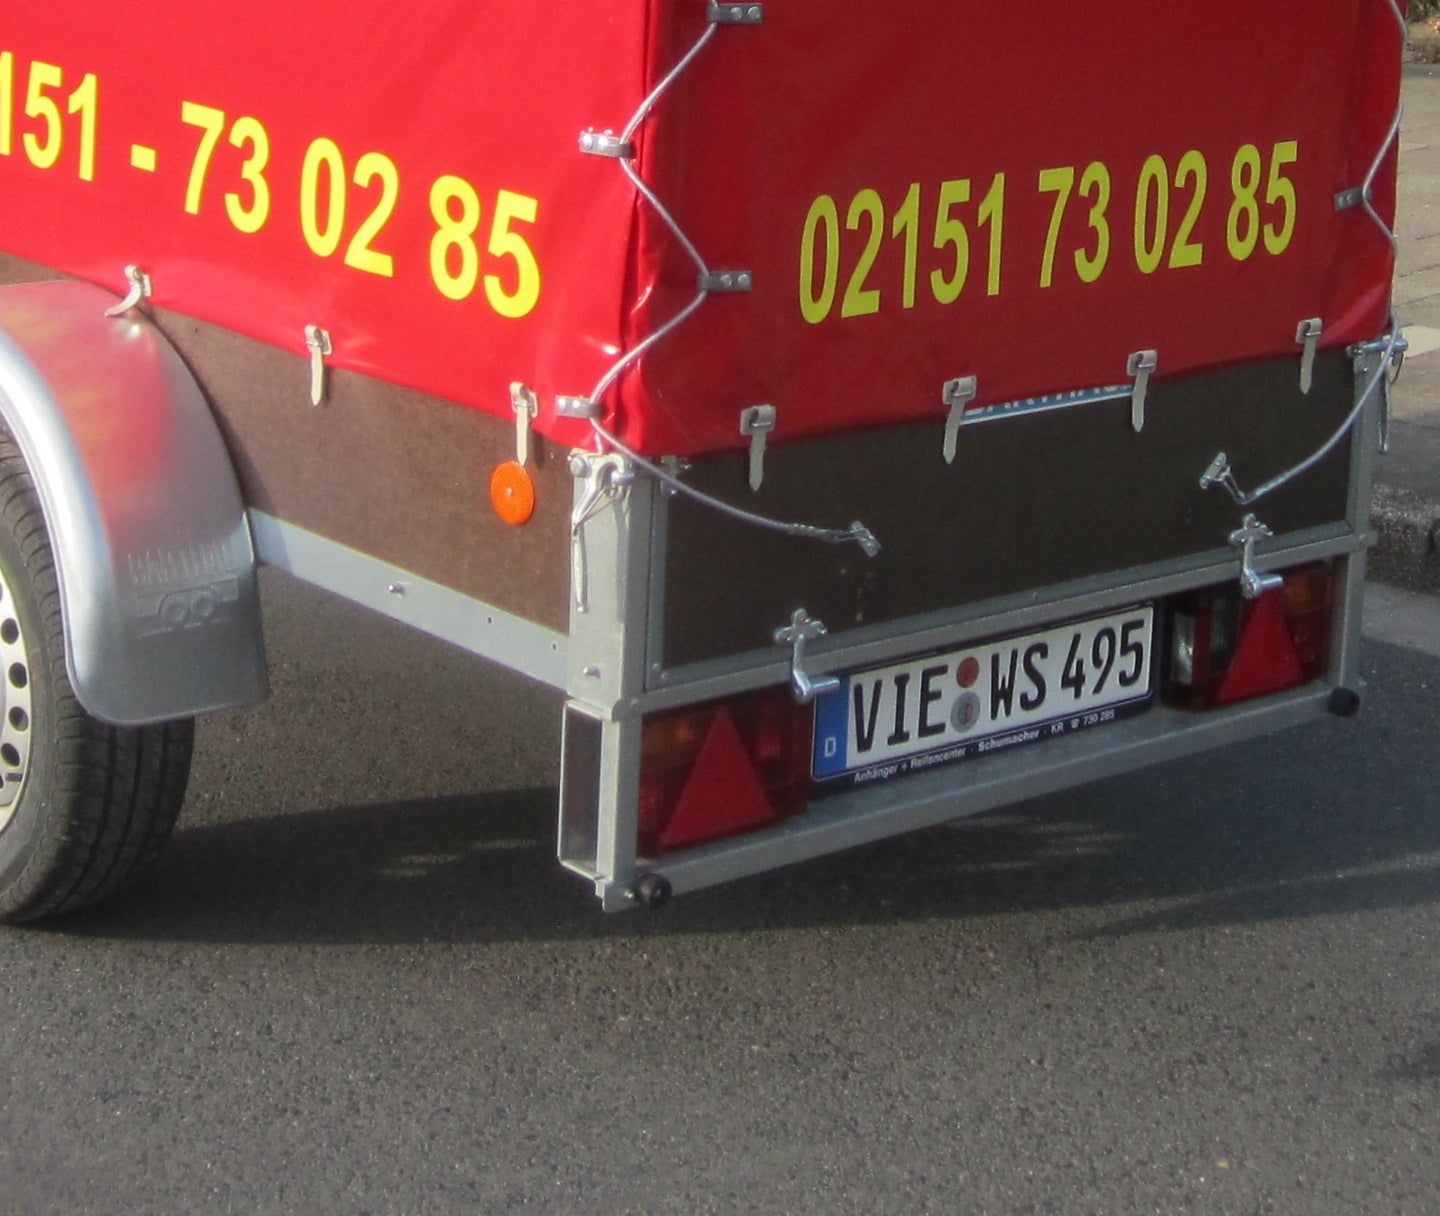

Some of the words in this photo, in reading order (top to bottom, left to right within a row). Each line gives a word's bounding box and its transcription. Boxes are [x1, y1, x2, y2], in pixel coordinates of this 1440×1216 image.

[180, 100, 273, 235] 73
[299, 136, 396, 279] 02
[428, 173, 542, 320] 85
[798, 172, 1006, 325] 02151
[1038, 161, 1110, 288] 73
[1134, 149, 1208, 275] 02
[1226, 140, 1299, 262] 85
[853, 664, 949, 754] VIE
[990, 641, 1049, 721] WS
[1061, 619, 1145, 700] 495
[978, 729, 1039, 753] Schumacher
[1050, 723, 1064, 735] KR
